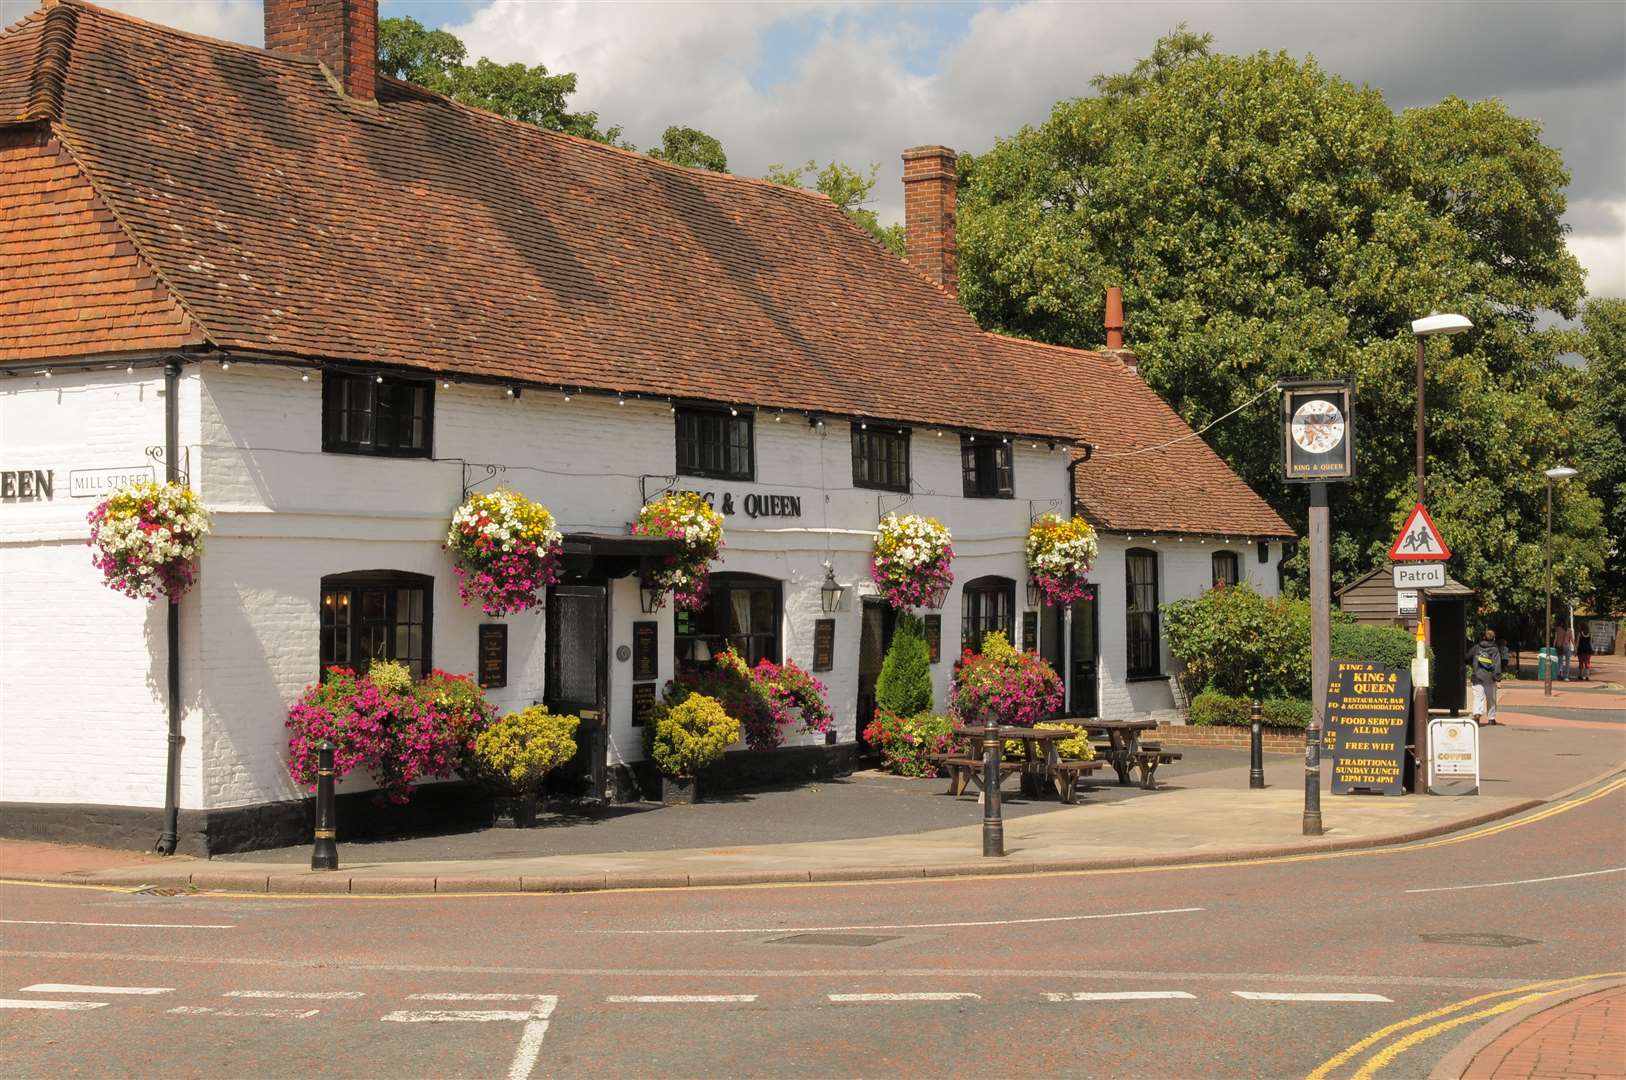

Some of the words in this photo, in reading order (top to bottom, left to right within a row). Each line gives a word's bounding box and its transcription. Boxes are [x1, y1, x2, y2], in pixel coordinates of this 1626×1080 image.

[0, 470, 54, 500] EEN
[75, 476, 102, 489] MILL
[106, 474, 149, 489] STREET
[721, 492, 735, 515] &
[744, 493, 802, 518] QUEEN
[1400, 568, 1439, 581] Patrol
[1353, 672, 1384, 682] KING
[1389, 673, 1398, 682] &
[1354, 683, 1395, 694] QUEEN
[1340, 717, 1366, 725] FOOD
[1367, 717, 1404, 726] SERVED
[1353, 726, 1371, 734] ALL
[1372, 726, 1390, 734] DAY
[1345, 742, 1369, 750] FREE
[1371, 743, 1394, 751] WIFI
[1339, 758, 1398, 767] TRADITIONAL
[1335, 766, 1370, 774] SUNDAY
[1370, 767, 1400, 775] LUNCH
